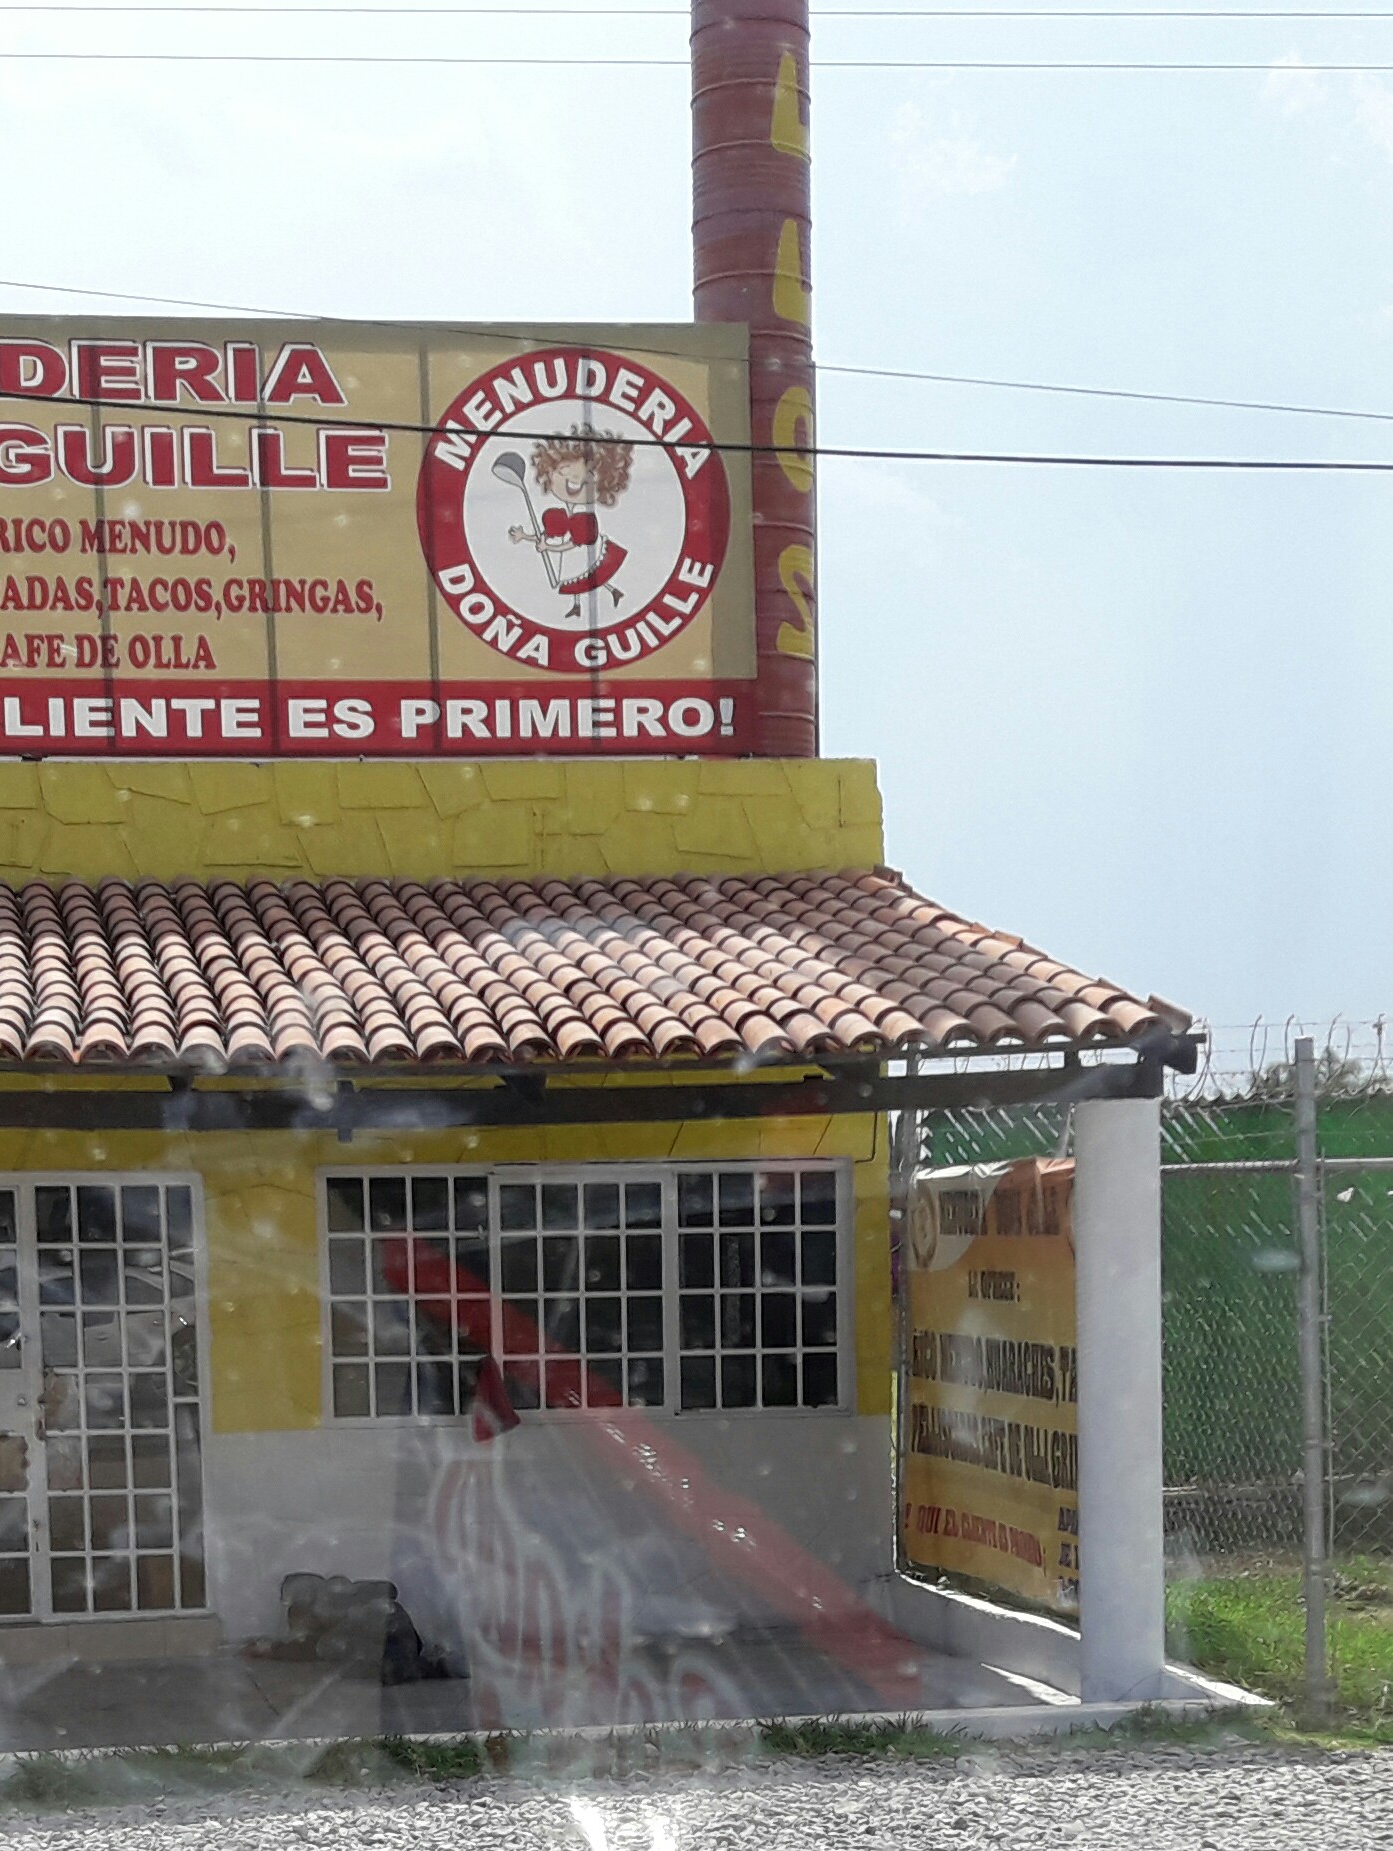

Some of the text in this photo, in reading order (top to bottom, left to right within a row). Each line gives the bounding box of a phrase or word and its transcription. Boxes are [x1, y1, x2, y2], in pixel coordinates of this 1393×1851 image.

[434, 357, 712, 479] MENUDERIA
[78, 519, 236, 564] MENUDO,
[438, 557, 714, 668] DOÑA GUILLE
[74, 633, 120, 670] DE
[127, 633, 217, 671] OLLA
[287, 698, 375, 739] ES
[400, 697, 735, 738] PRIMERO!
